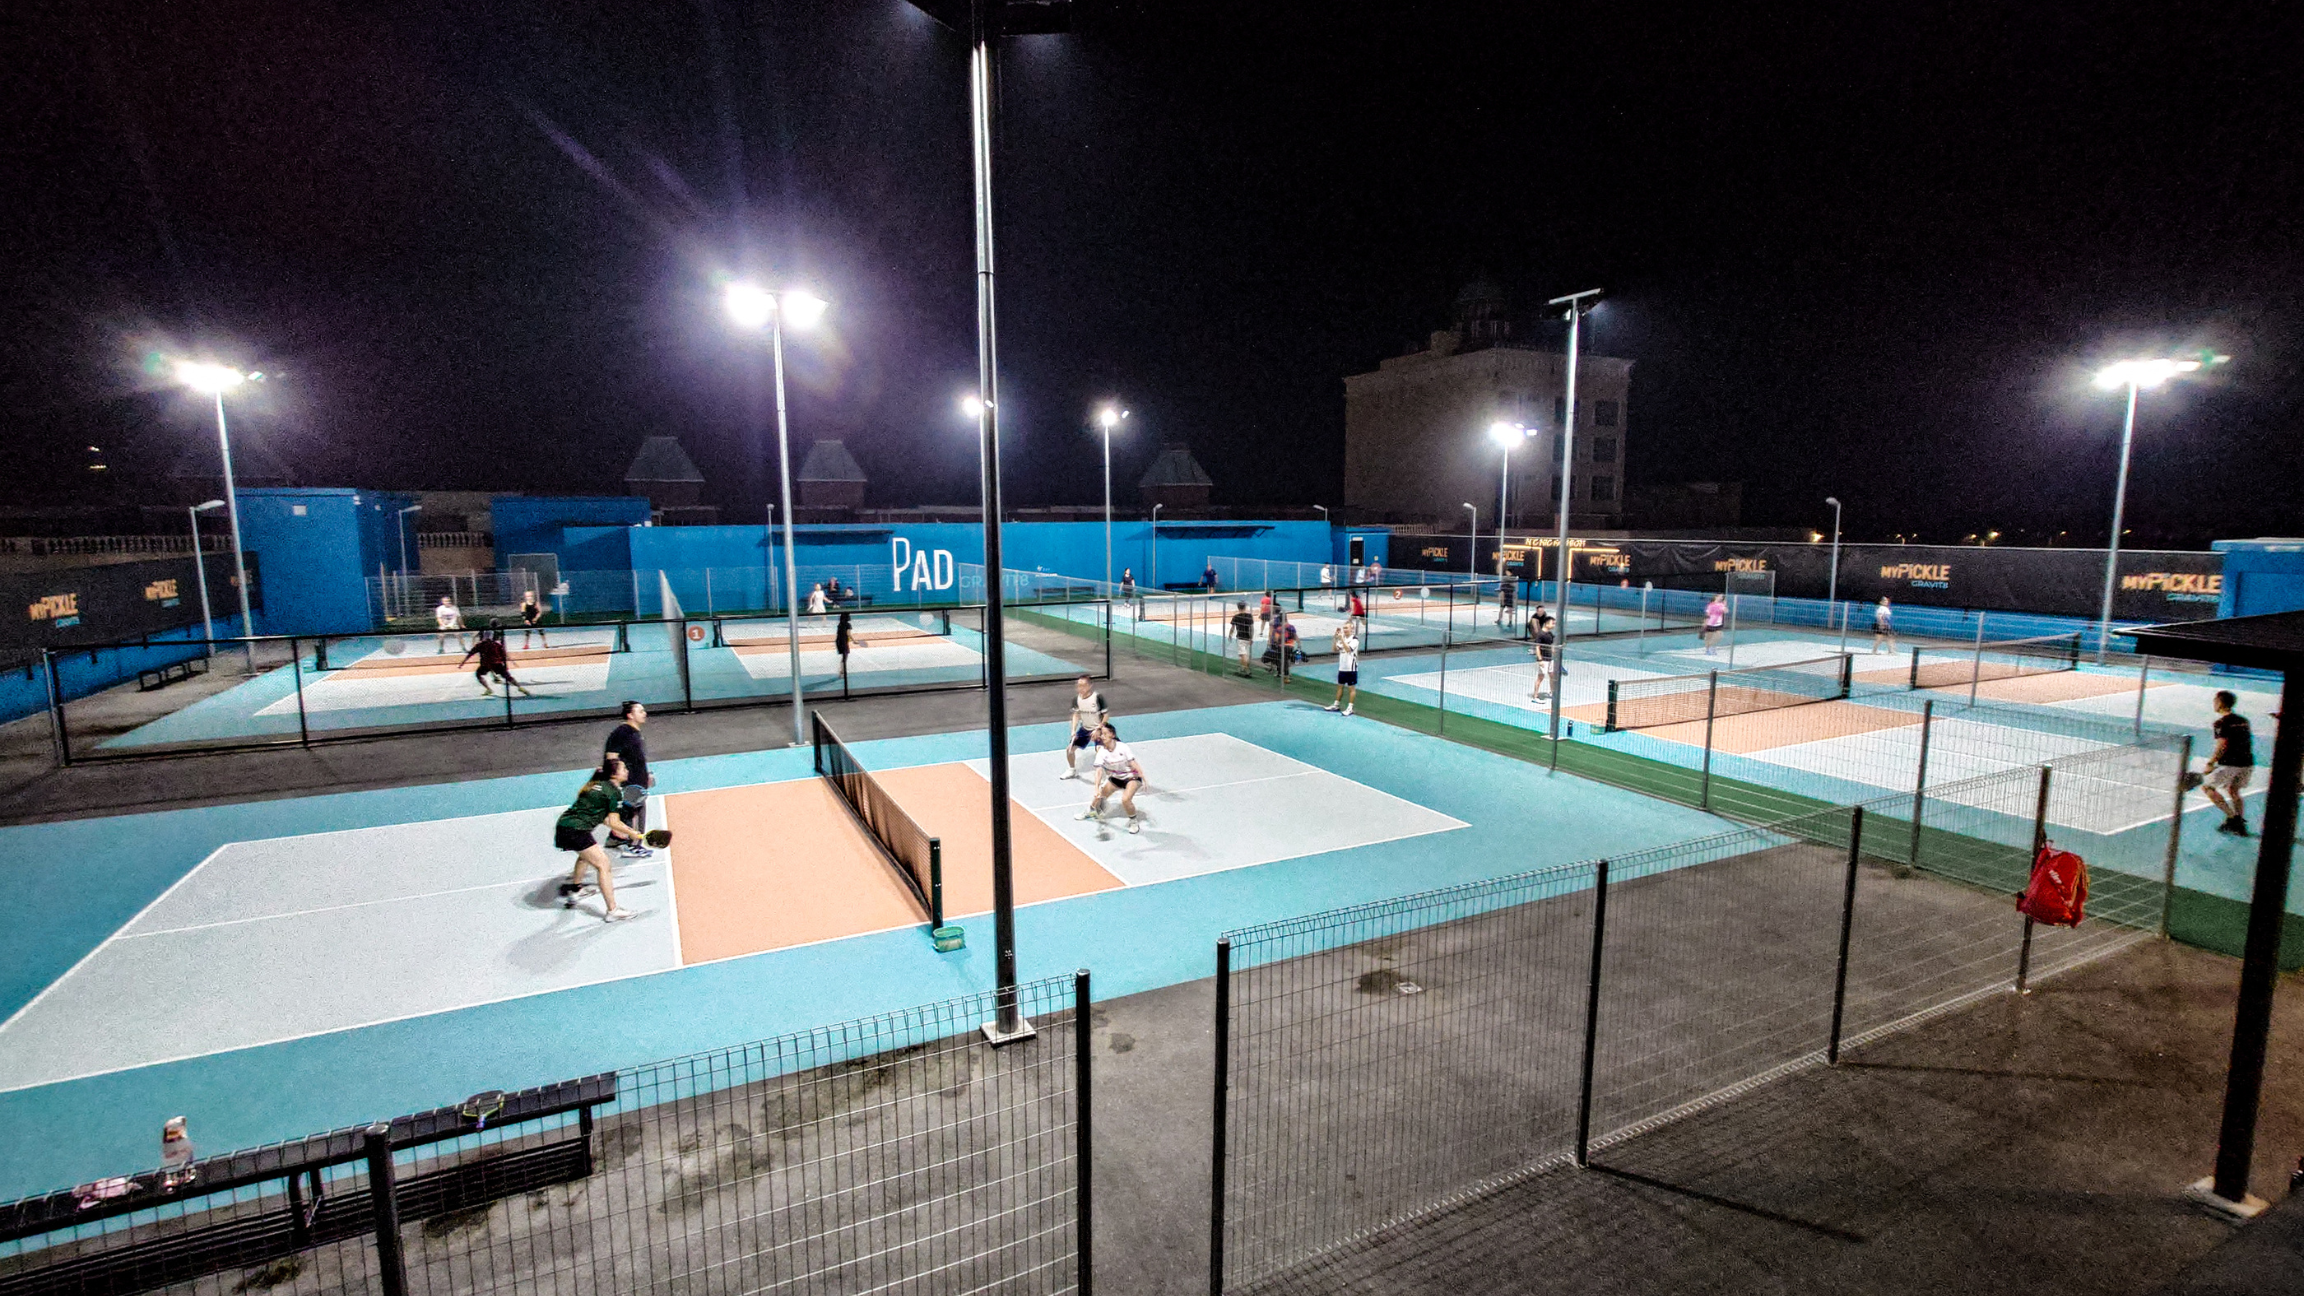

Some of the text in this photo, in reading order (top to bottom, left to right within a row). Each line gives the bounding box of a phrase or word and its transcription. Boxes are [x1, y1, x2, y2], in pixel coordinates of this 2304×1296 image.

[892, 537, 954, 592] PAD
[960, 574, 1029, 588] GRIT8
[1394, 590, 1401, 599] 2
[692, 628, 702, 639] 1
